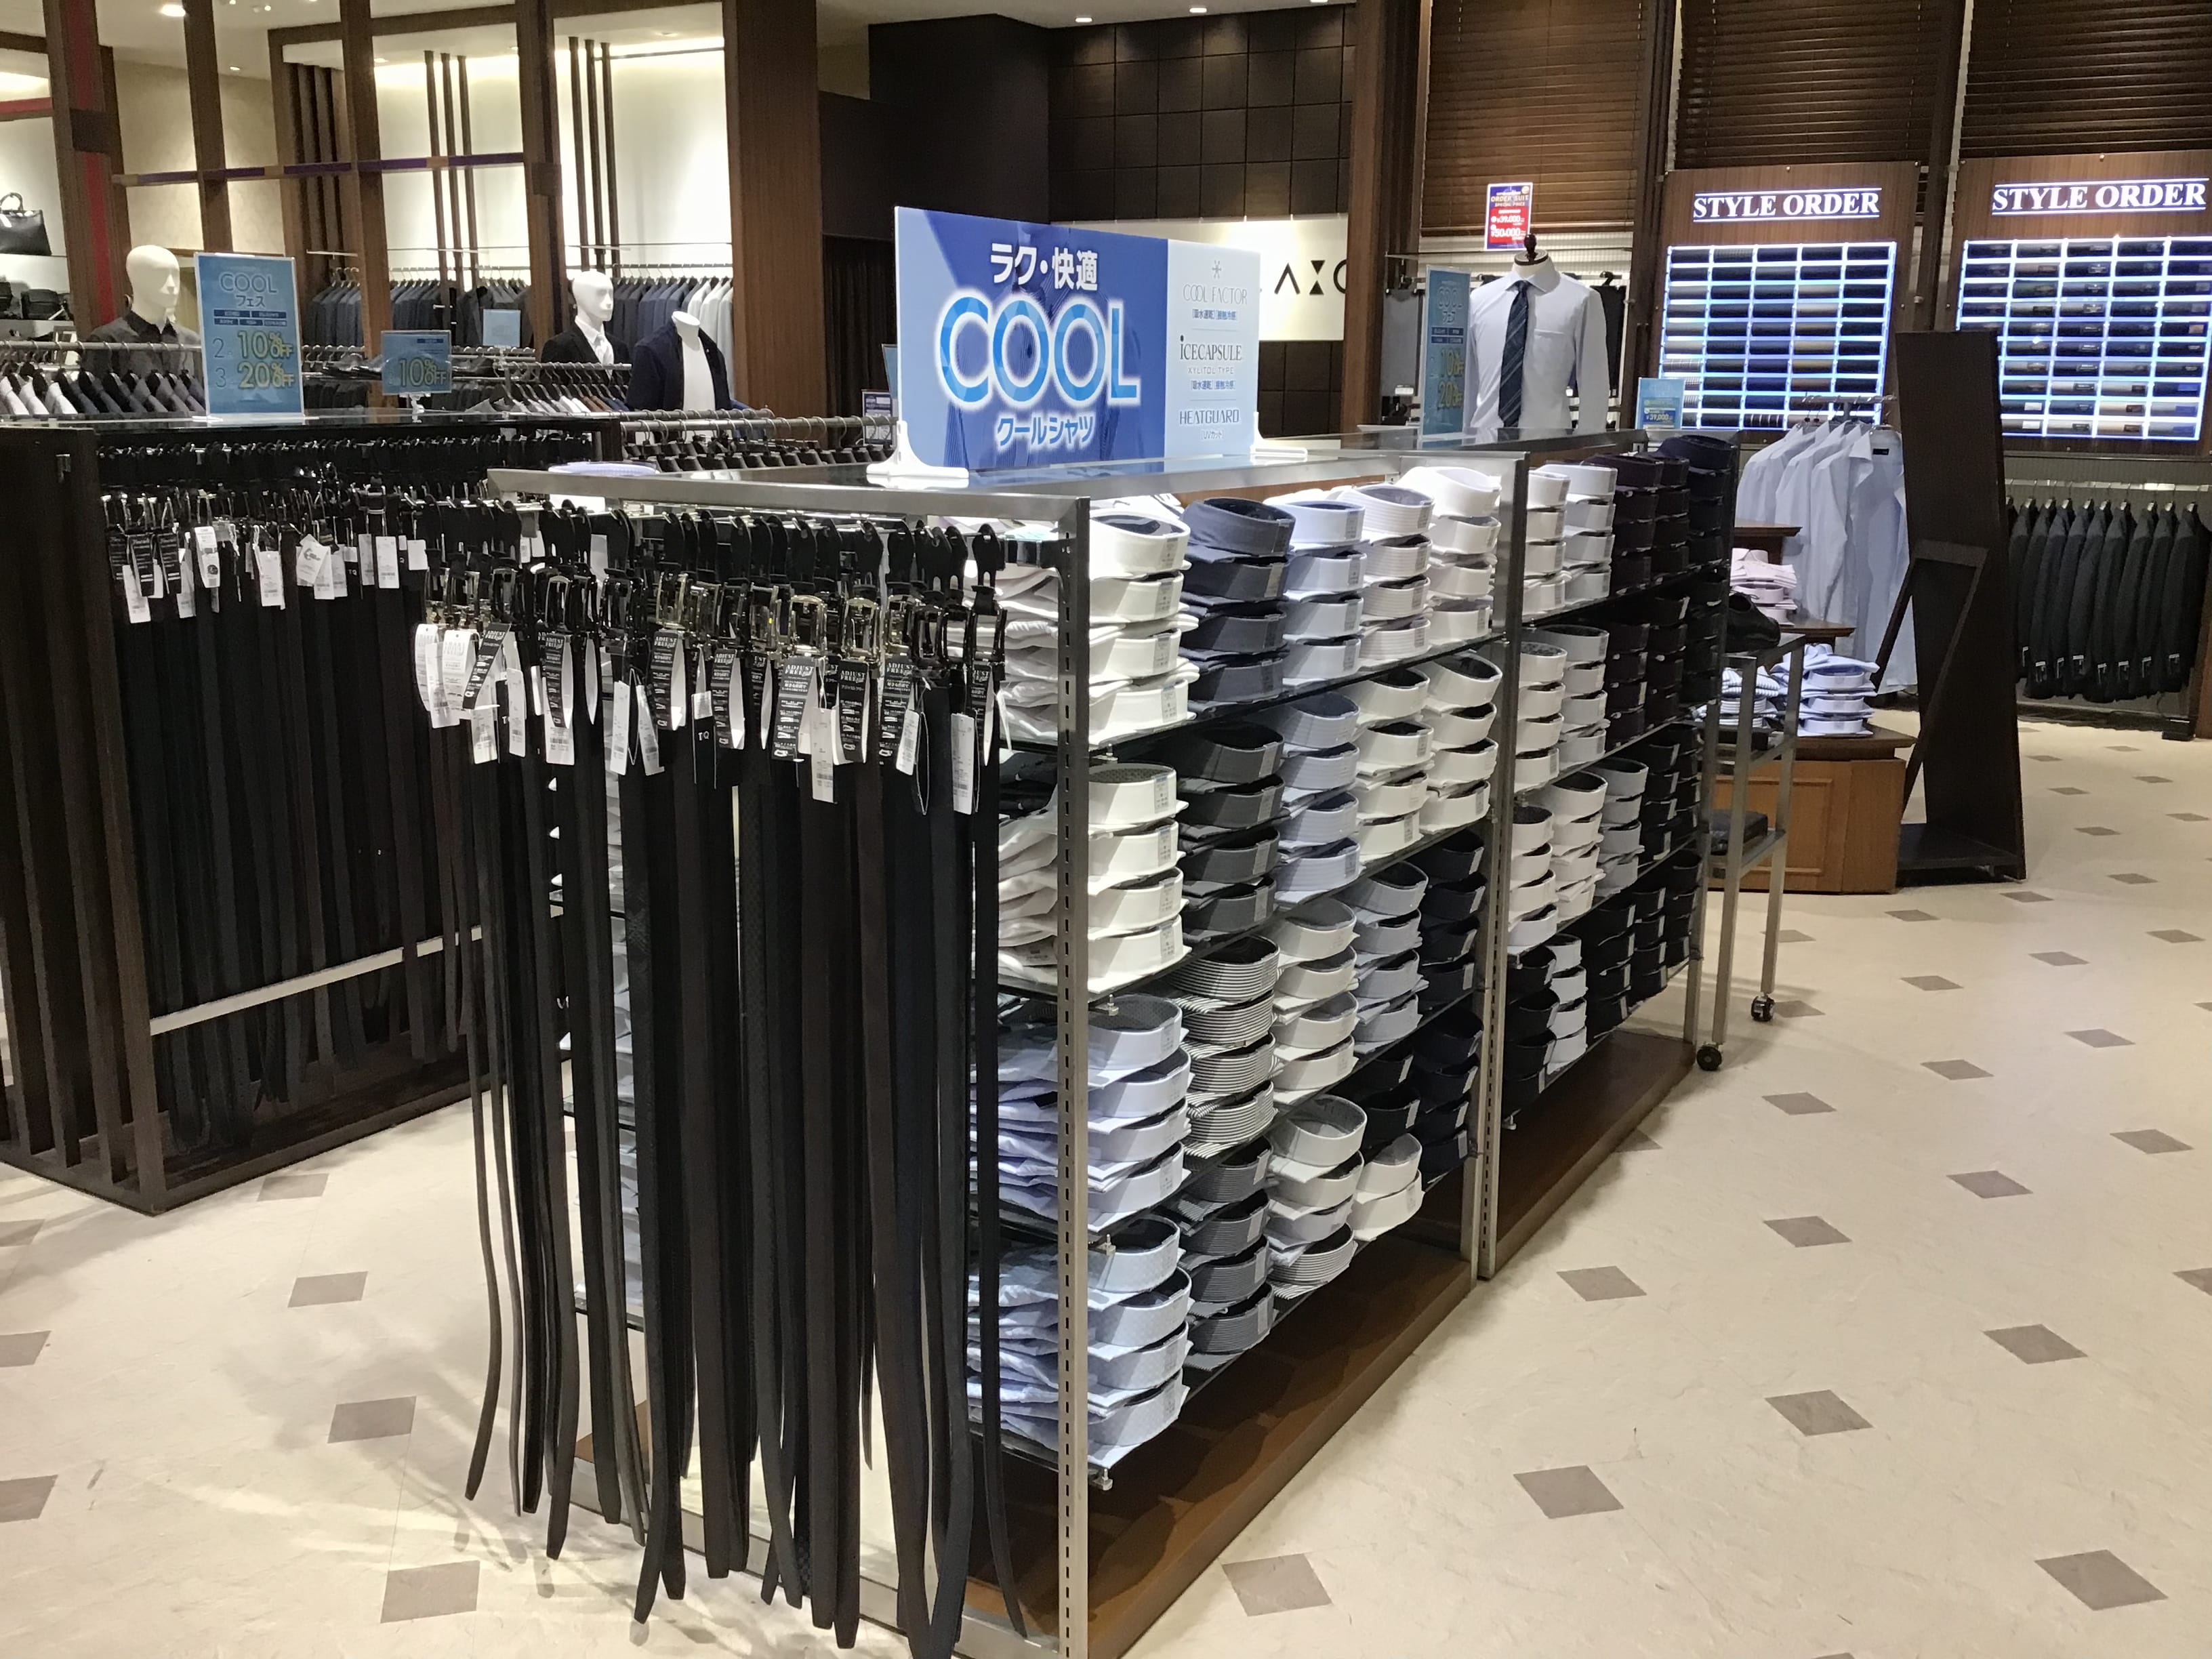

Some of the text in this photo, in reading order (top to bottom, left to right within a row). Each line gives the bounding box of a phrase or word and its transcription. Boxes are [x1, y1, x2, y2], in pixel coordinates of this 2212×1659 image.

[1694, 192, 1880, 218] STYLE ORDER
[1992, 183, 2207, 210] STYLE ORDER
[990, 242, 1098, 291] ラク・快適
[220, 273, 278, 293] COOL
[236, 295, 266, 307] フェス
[1183, 284, 1248, 305] COOL FACTOR
[212, 337, 224, 358] 2
[939, 294, 1139, 405] COOL
[216, 367, 226, 388] 3
[1179, 409, 1240, 425] HEATGUARD
[997, 415, 1094, 447] クールシャツ
